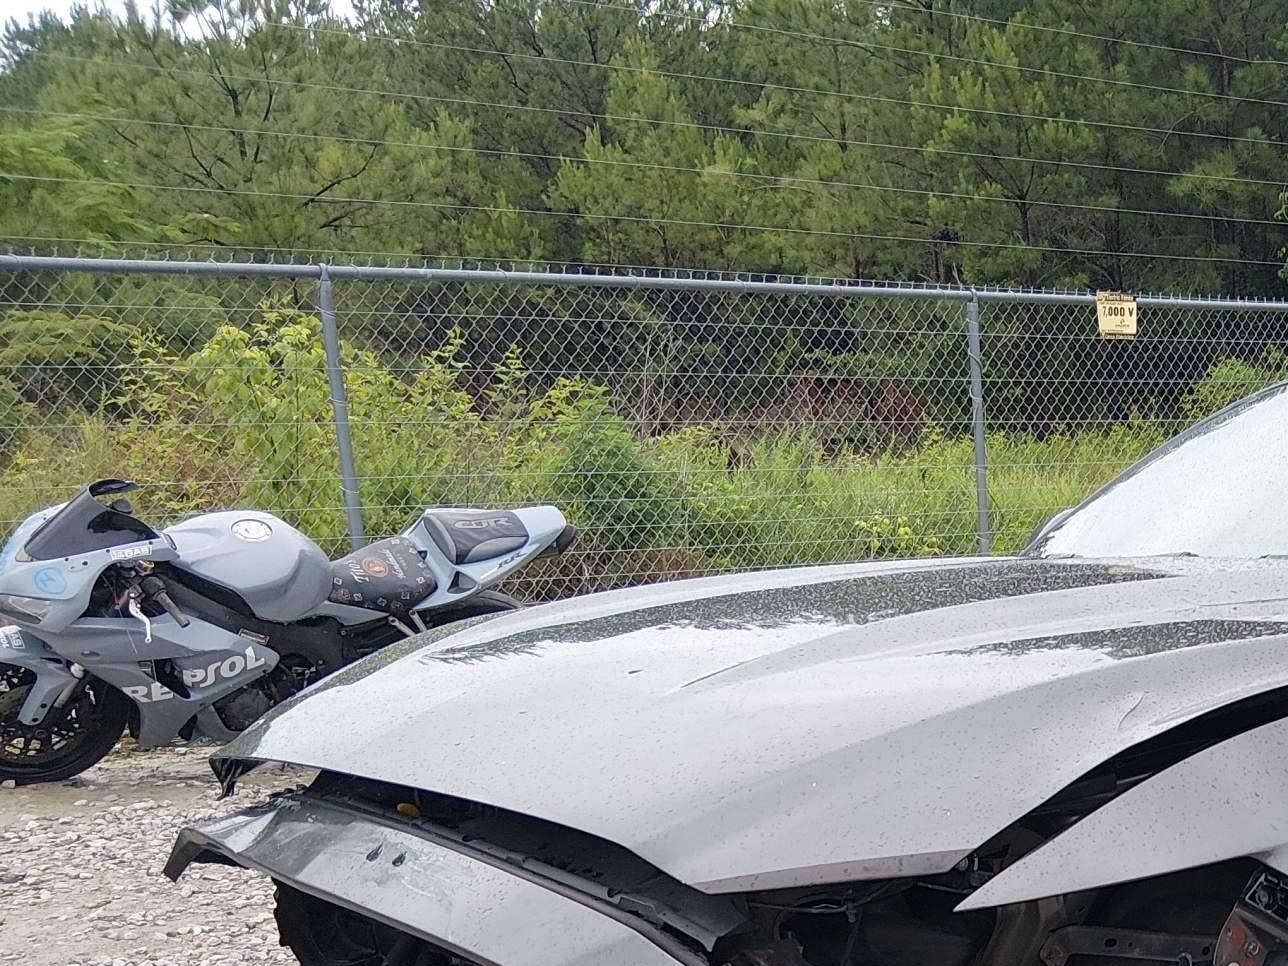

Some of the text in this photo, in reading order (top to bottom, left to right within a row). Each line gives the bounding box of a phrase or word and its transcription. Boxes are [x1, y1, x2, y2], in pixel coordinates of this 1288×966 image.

[1102, 306, 1134, 318] 7,000 V
[454, 517, 513, 529] CBR
[121, 645, 265, 703] REPSOL
